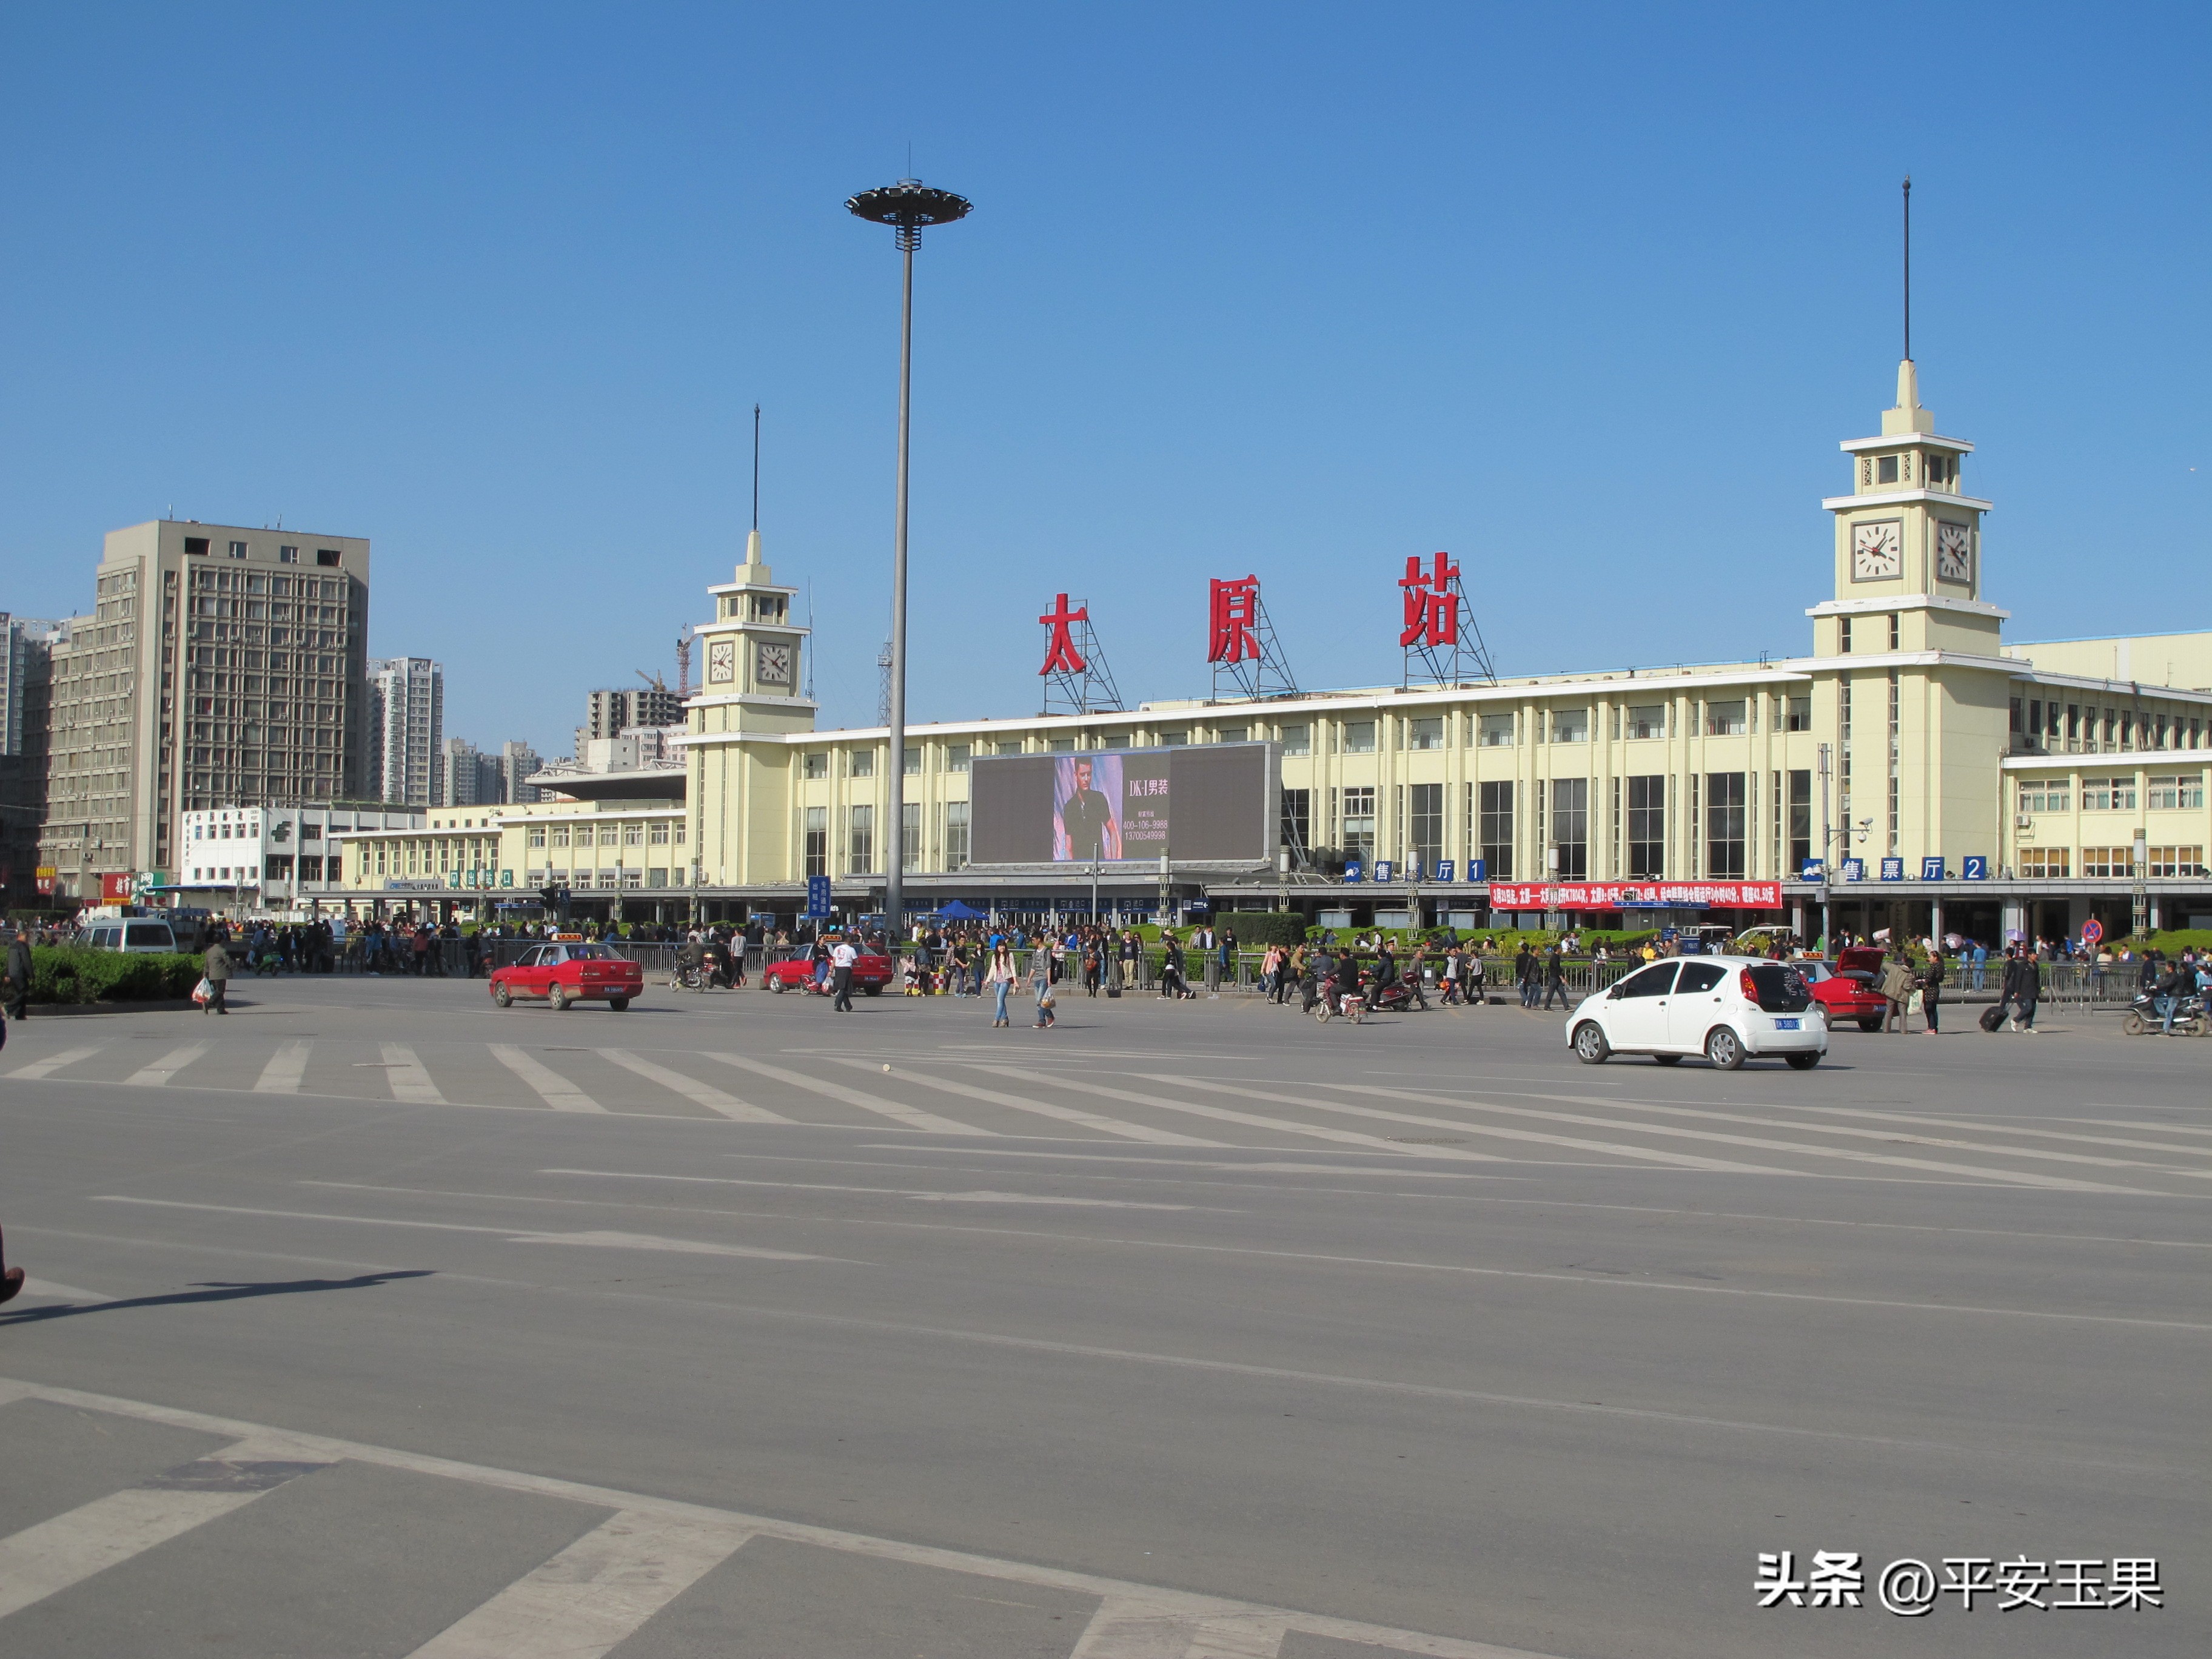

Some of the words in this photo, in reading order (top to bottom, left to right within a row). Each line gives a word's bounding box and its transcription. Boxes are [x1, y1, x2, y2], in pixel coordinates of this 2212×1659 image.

[1038, 551, 1461, 676] 太原站
[1376, 863, 1478, 880] 售厅1
[1843, 859, 1979, 880] 售票厅2
